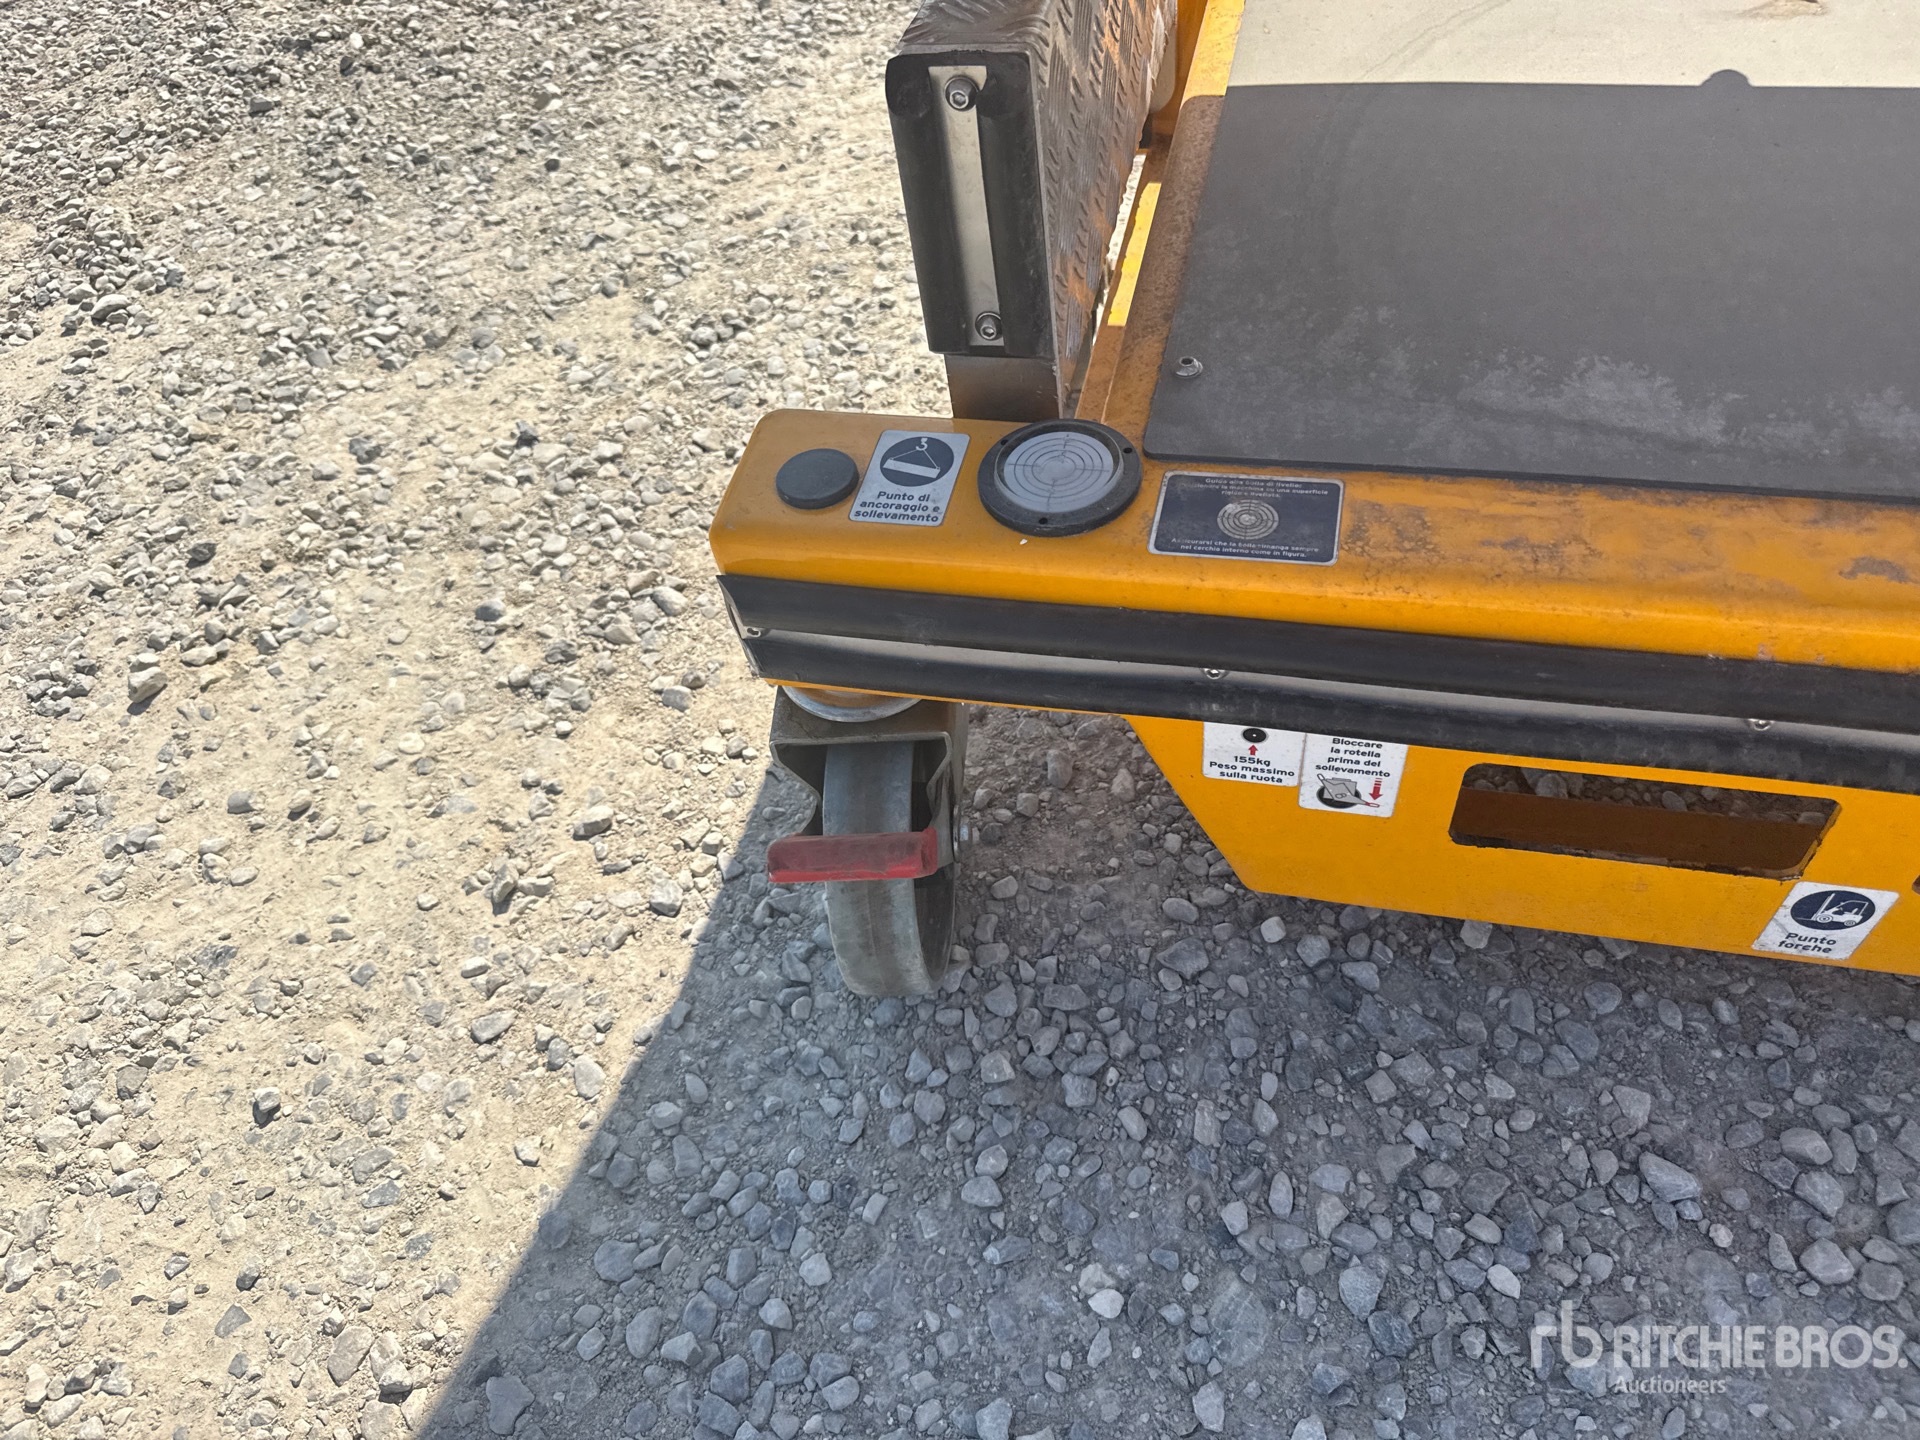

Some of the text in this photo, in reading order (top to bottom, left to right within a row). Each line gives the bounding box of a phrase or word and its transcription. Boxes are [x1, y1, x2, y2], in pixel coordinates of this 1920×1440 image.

[877, 491, 930, 502] Punto di
[860, 501, 929, 512] ancoraggio
[854, 510, 939, 522] sollevamento
[1332, 737, 1383, 749] Bloccare
[1344, 749, 1381, 758] rotella
[1234, 756, 1271, 767] 155kg
[1327, 756, 1381, 768] prima del
[1210, 761, 1295, 777] Peso massimo
[1315, 764, 1390, 777] sollevamento
[1219, 771, 1283, 783] sulla ruota
[1785, 932, 1837, 945] Punto
[1778, 940, 1832, 954] forche
